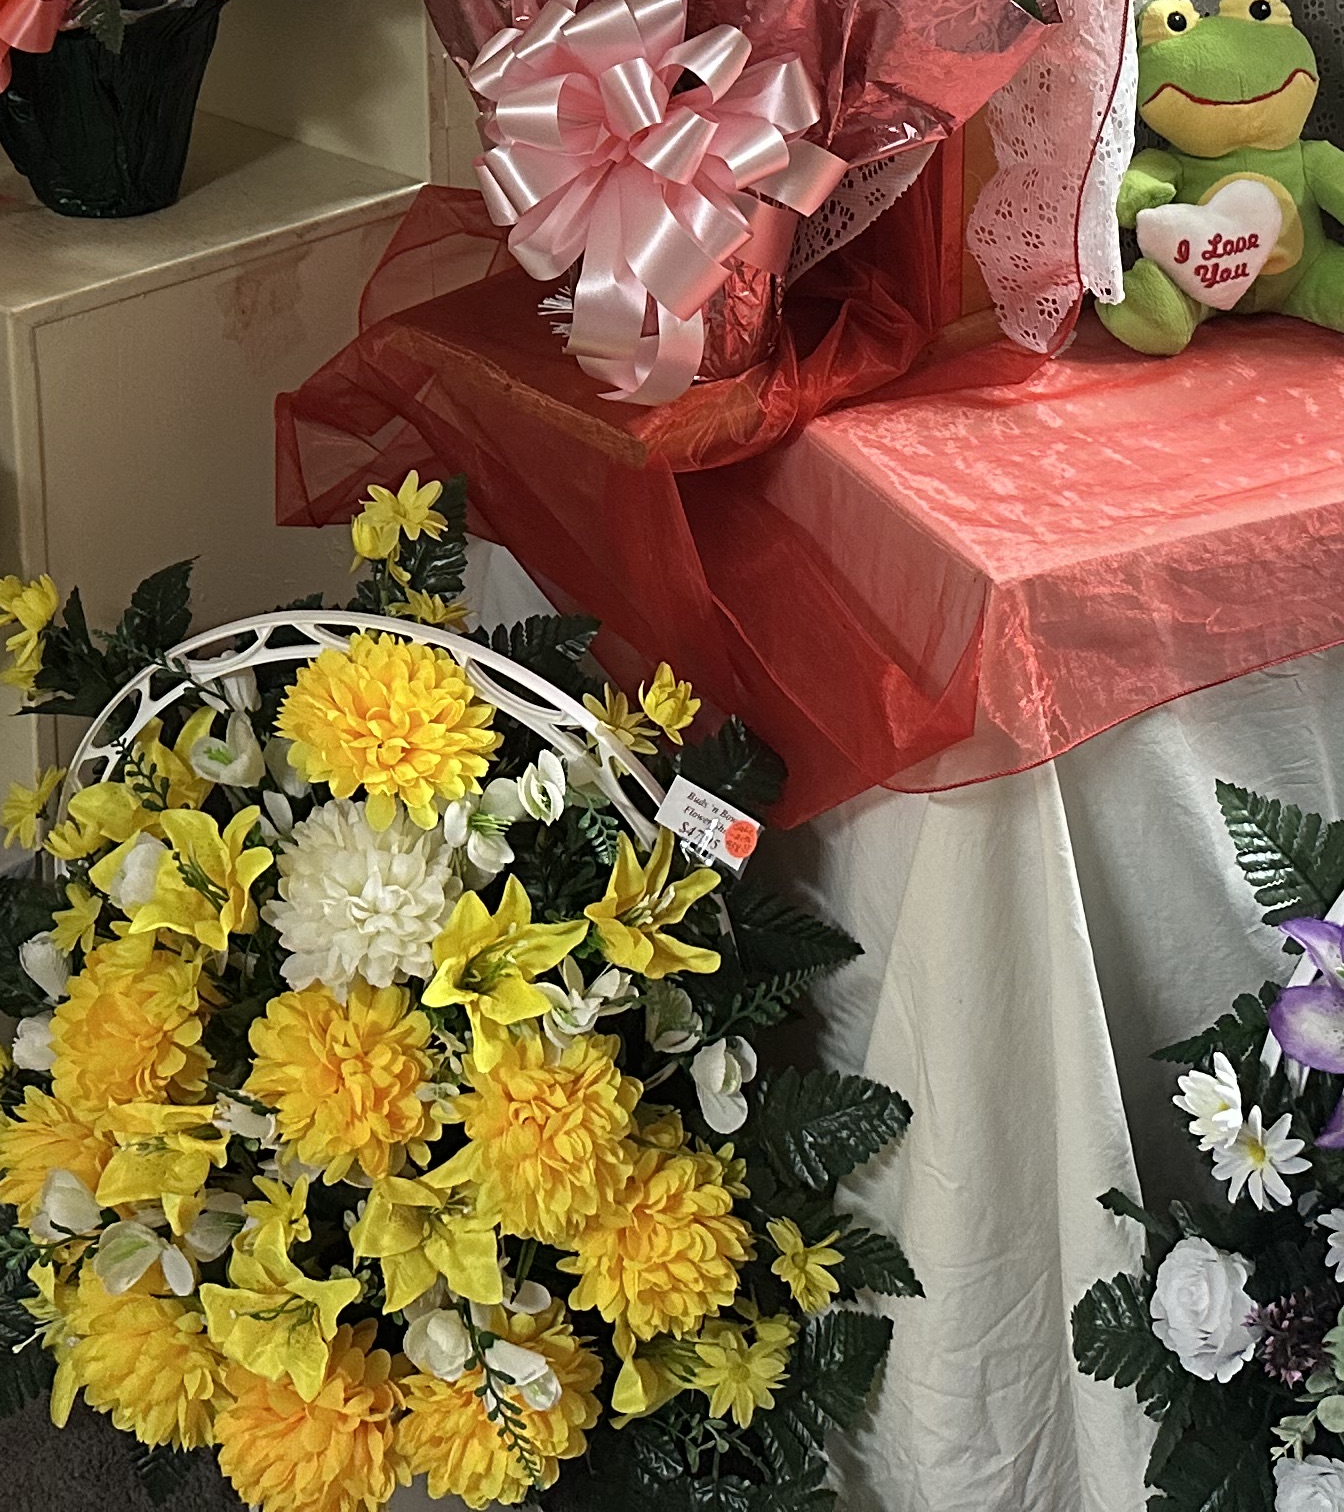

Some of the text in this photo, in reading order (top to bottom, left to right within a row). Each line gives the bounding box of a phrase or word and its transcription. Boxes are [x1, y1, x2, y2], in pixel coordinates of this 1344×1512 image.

[1173, 233, 1261, 264] I Love
[1194, 262, 1250, 288] You
[687, 791, 708, 809] Buds
